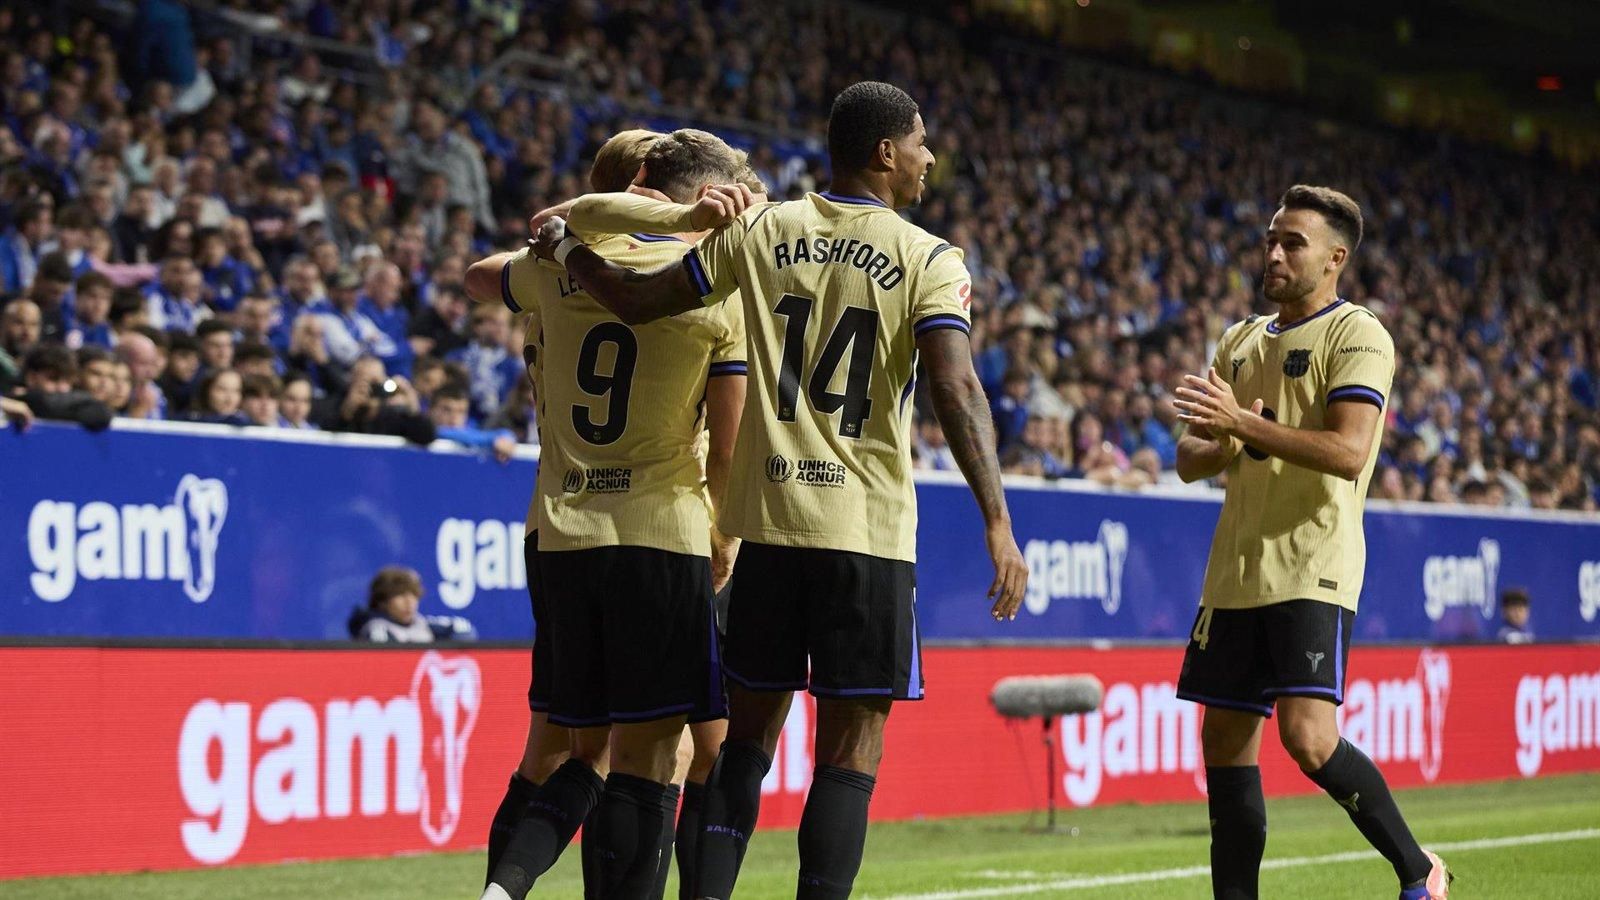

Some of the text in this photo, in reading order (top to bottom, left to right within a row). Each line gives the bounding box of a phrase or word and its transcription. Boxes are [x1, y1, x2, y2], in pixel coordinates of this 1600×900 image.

[774, 237, 904, 292] RASHFORD
[571, 320, 639, 447] 9
[773, 293, 879, 439] 14
[586, 468, 633, 479] UNHCR
[586, 478, 631, 490] ACNUR
[796, 471, 845, 485] ACNUR
[797, 460, 846, 475] UNHCR
[28, 498, 188, 603] gam
[1336, 678, 1425, 764] am
[178, 696, 424, 865] gam
